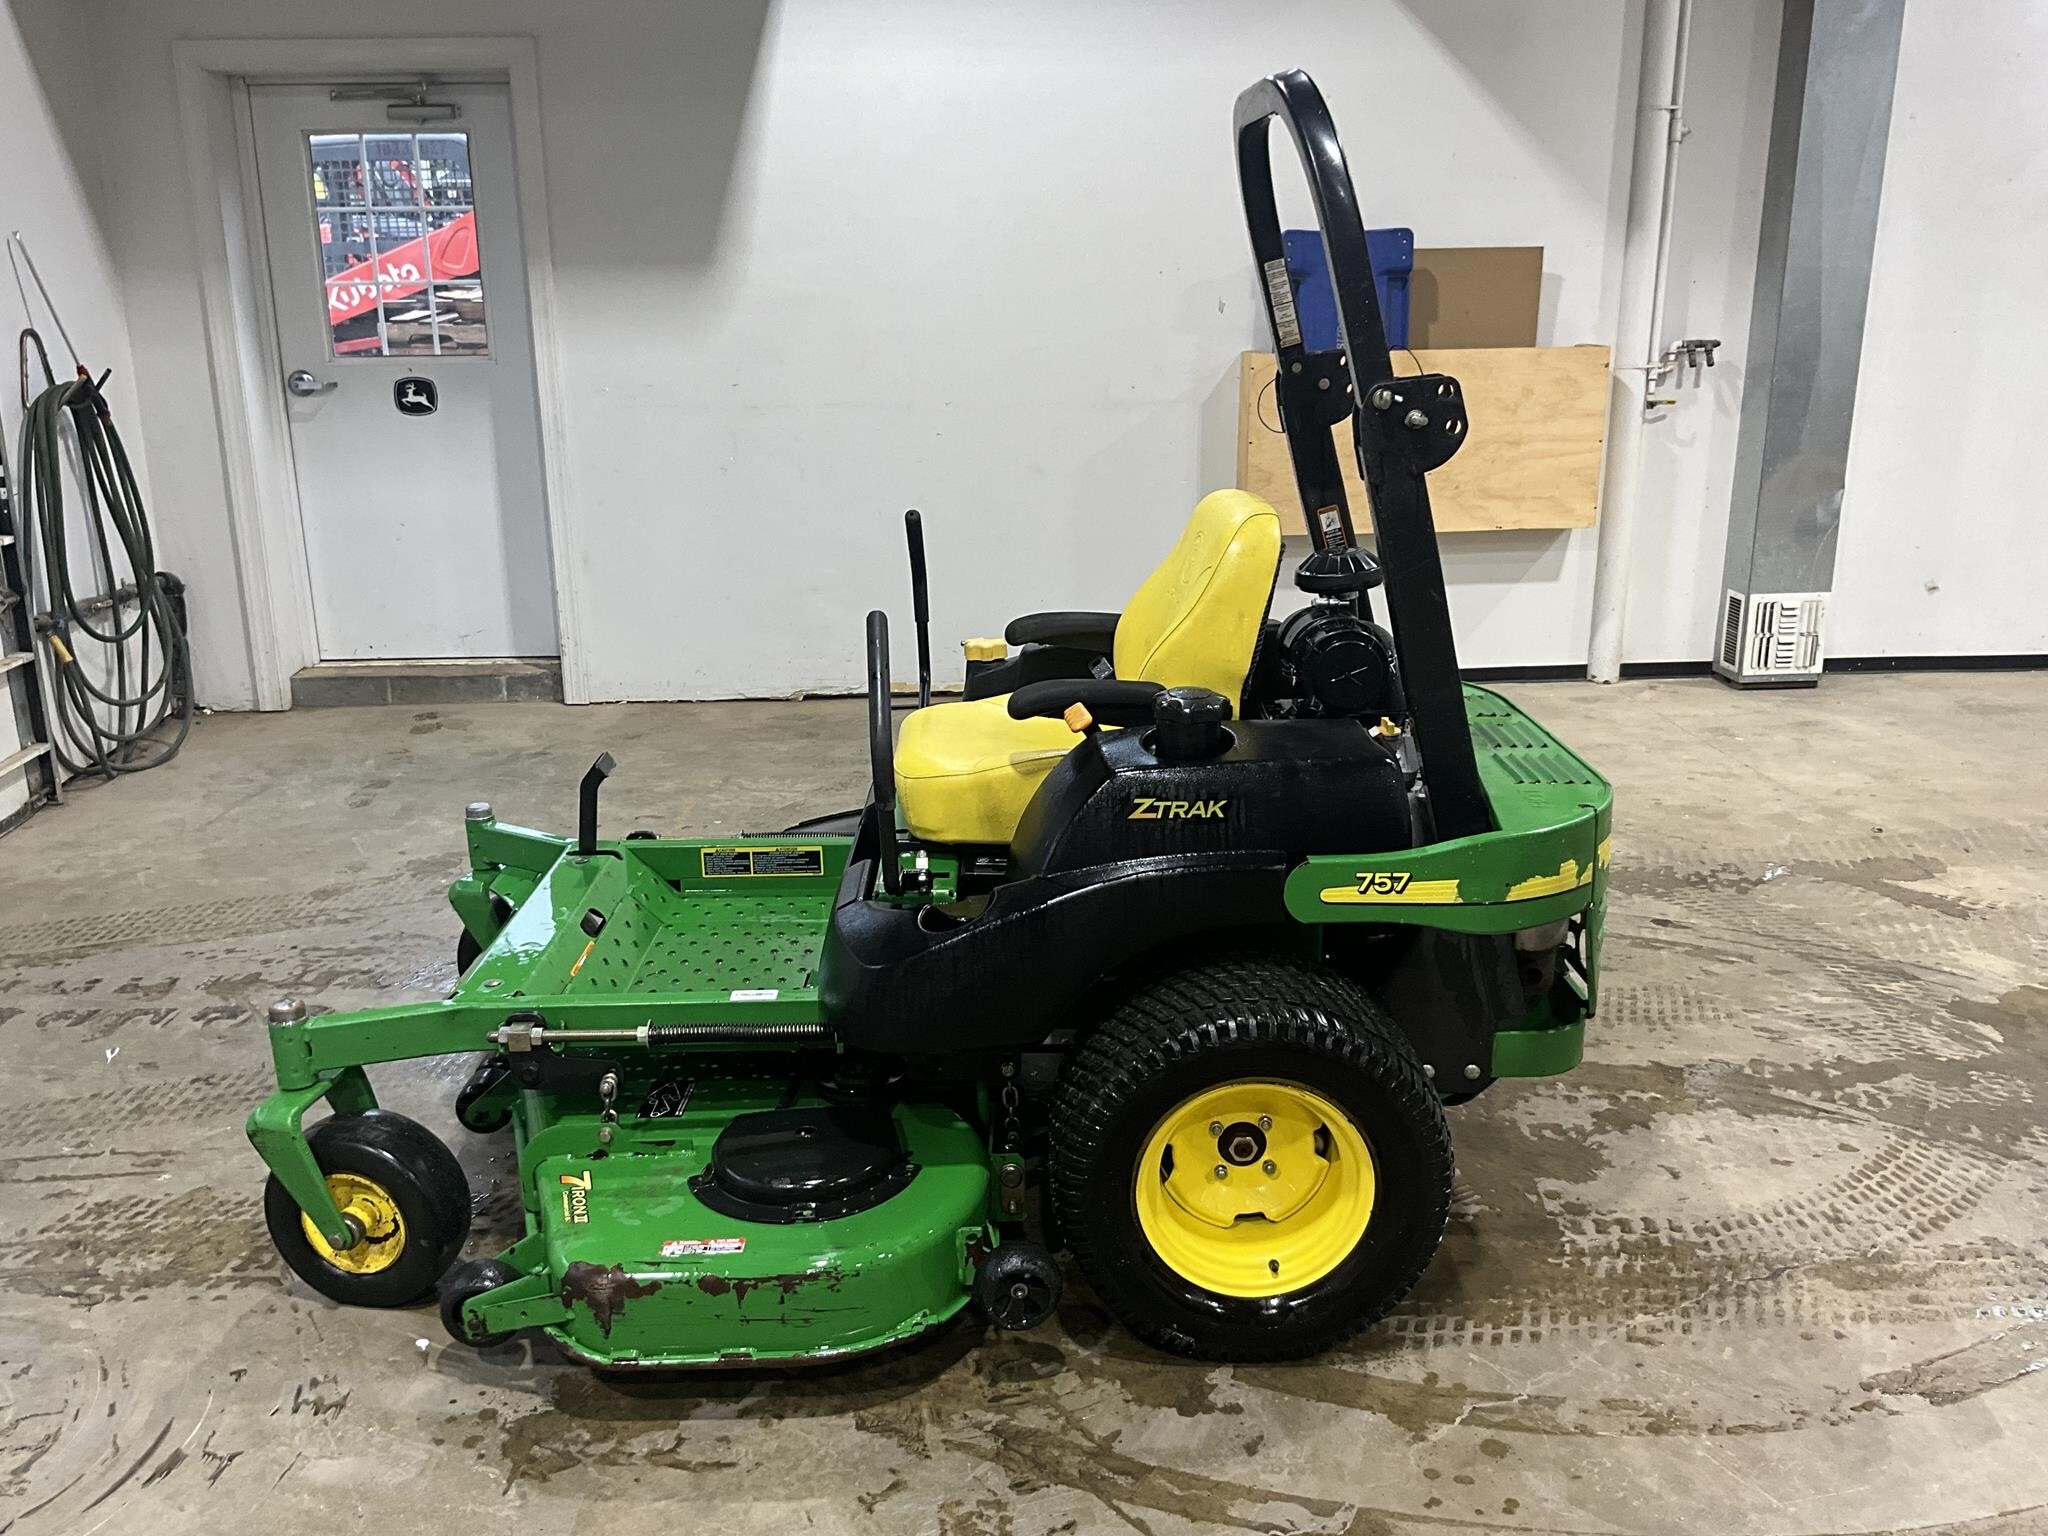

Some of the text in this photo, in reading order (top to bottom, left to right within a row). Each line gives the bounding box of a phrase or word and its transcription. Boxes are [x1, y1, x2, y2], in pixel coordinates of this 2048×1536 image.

[329, 263, 421, 311] Kubota
[1127, 798, 1228, 819] ZTRAK
[1356, 872, 1412, 894] 757
